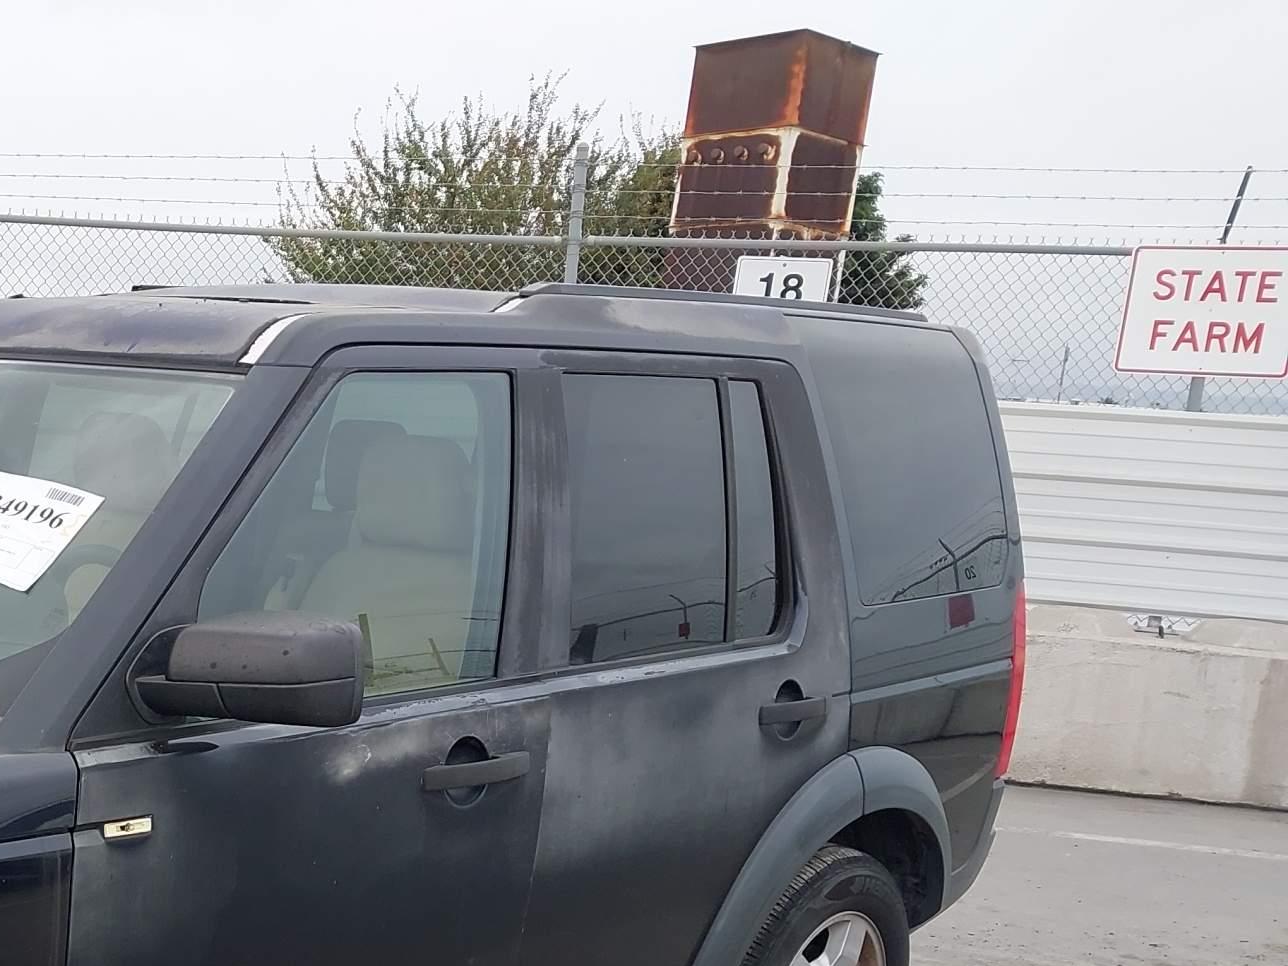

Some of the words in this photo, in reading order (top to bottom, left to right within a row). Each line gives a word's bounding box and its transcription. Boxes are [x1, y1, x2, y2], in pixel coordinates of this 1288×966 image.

[759, 272, 804, 300] 18
[1152, 268, 1283, 303] STATE
[1148, 319, 1266, 354] FARM
